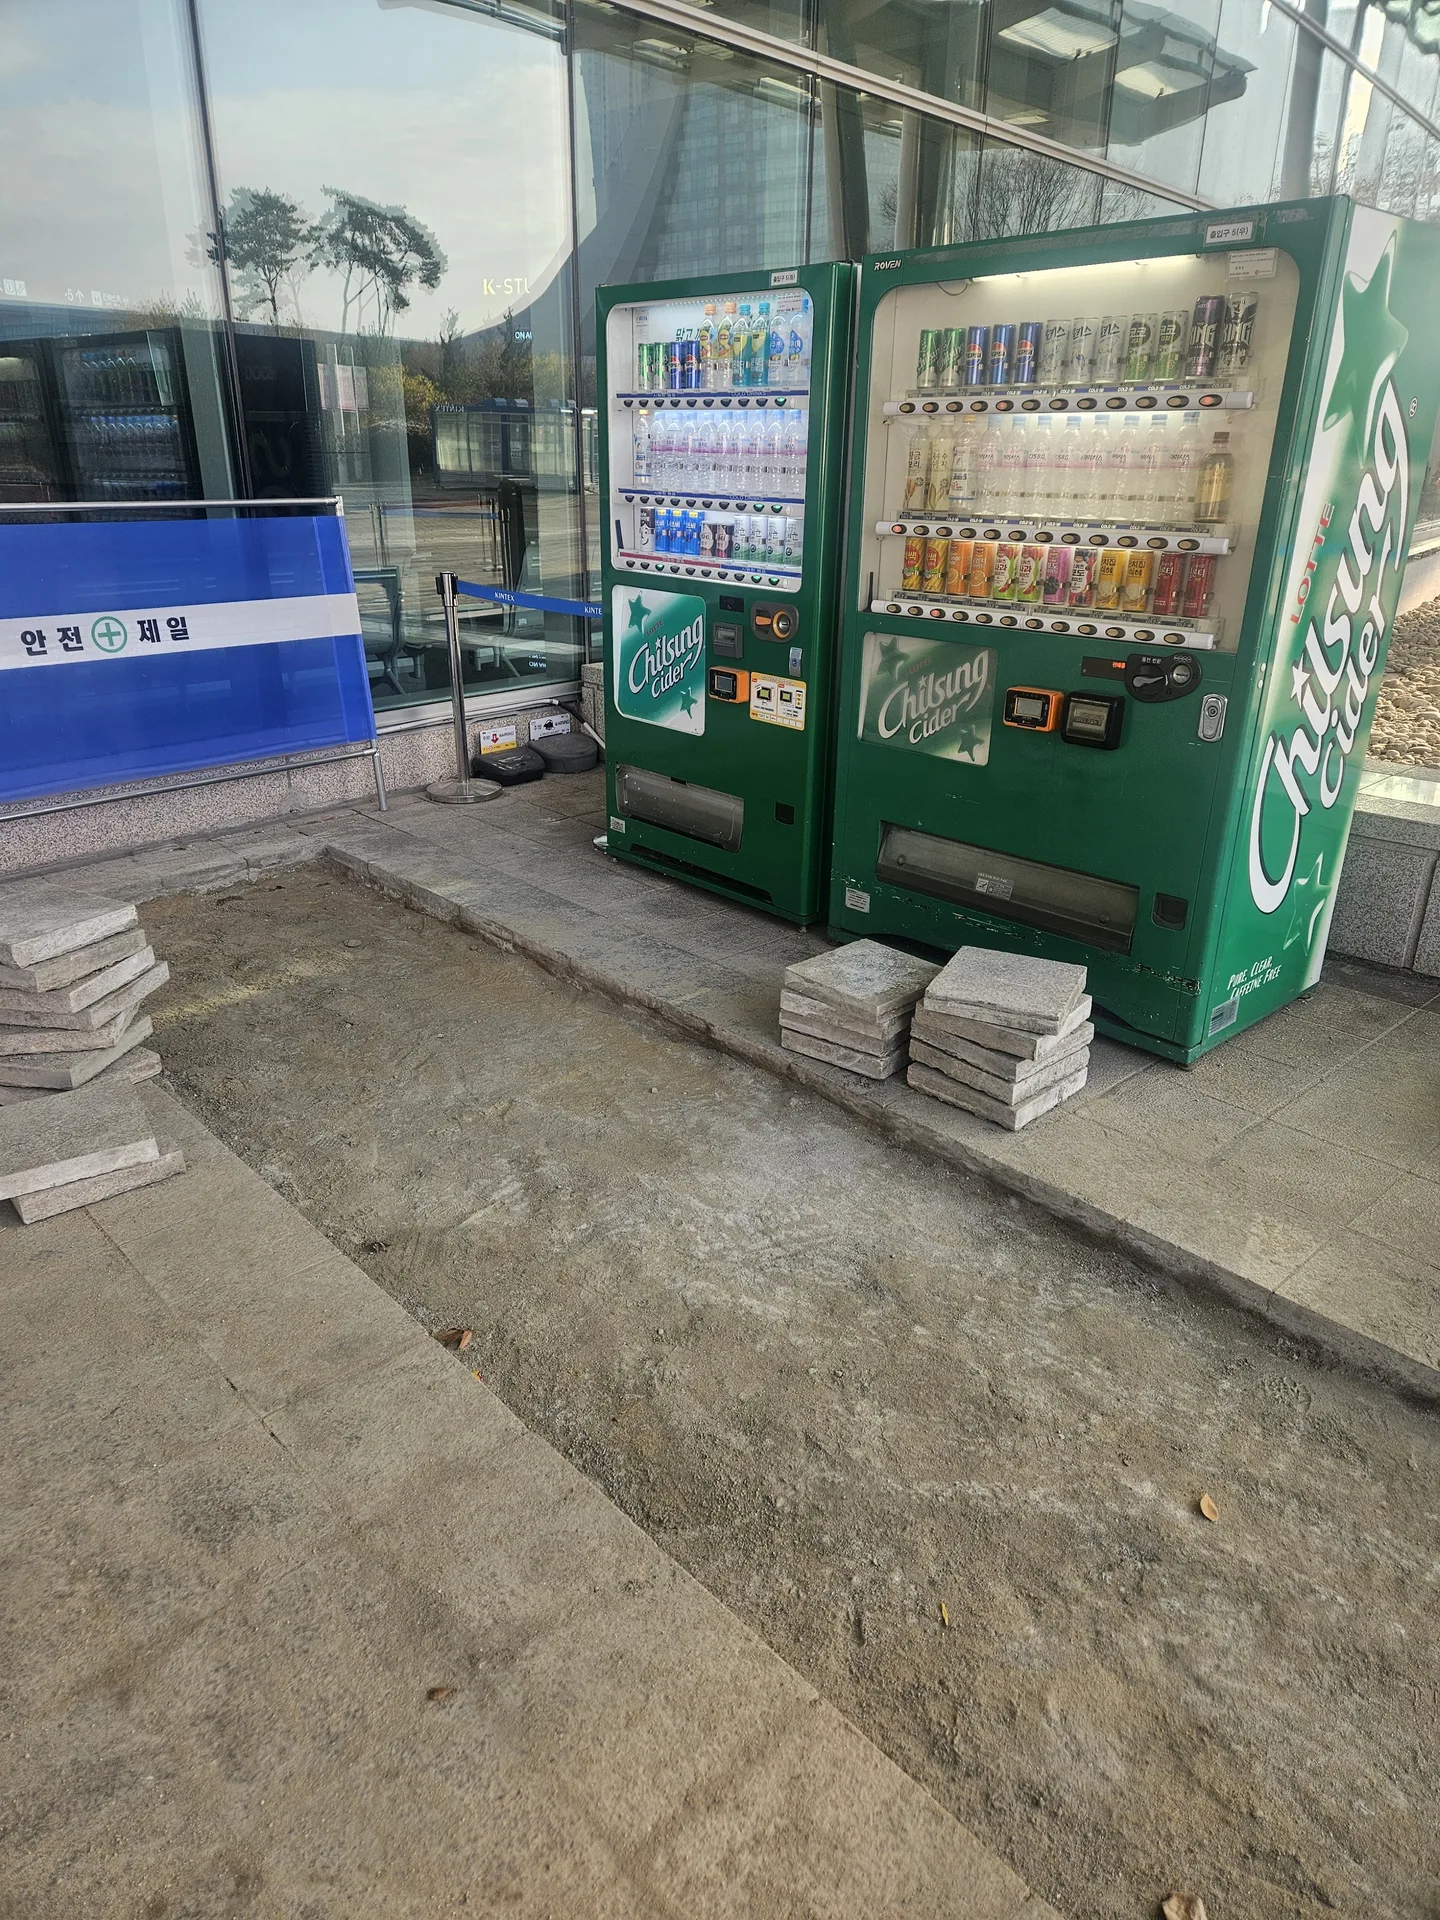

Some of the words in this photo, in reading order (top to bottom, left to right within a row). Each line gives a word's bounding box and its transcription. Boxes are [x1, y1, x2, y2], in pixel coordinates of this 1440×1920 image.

[1210, 229, 1230, 239] 출입구
[874, 259, 902, 271] ROVEN
[1289, 502, 1335, 625] LOTTE
[494, 591, 515, 602] KINTEX
[628, 614, 703, 694] Chilsung
[1248, 379, 1410, 914] Chilsung
[1321, 522, 1392, 809] Cider
[651, 652, 693, 698] Cider
[878, 649, 989, 739] Chilsung
[909, 692, 972, 744] Cider
[1262, 964, 1282, 984] FREE
